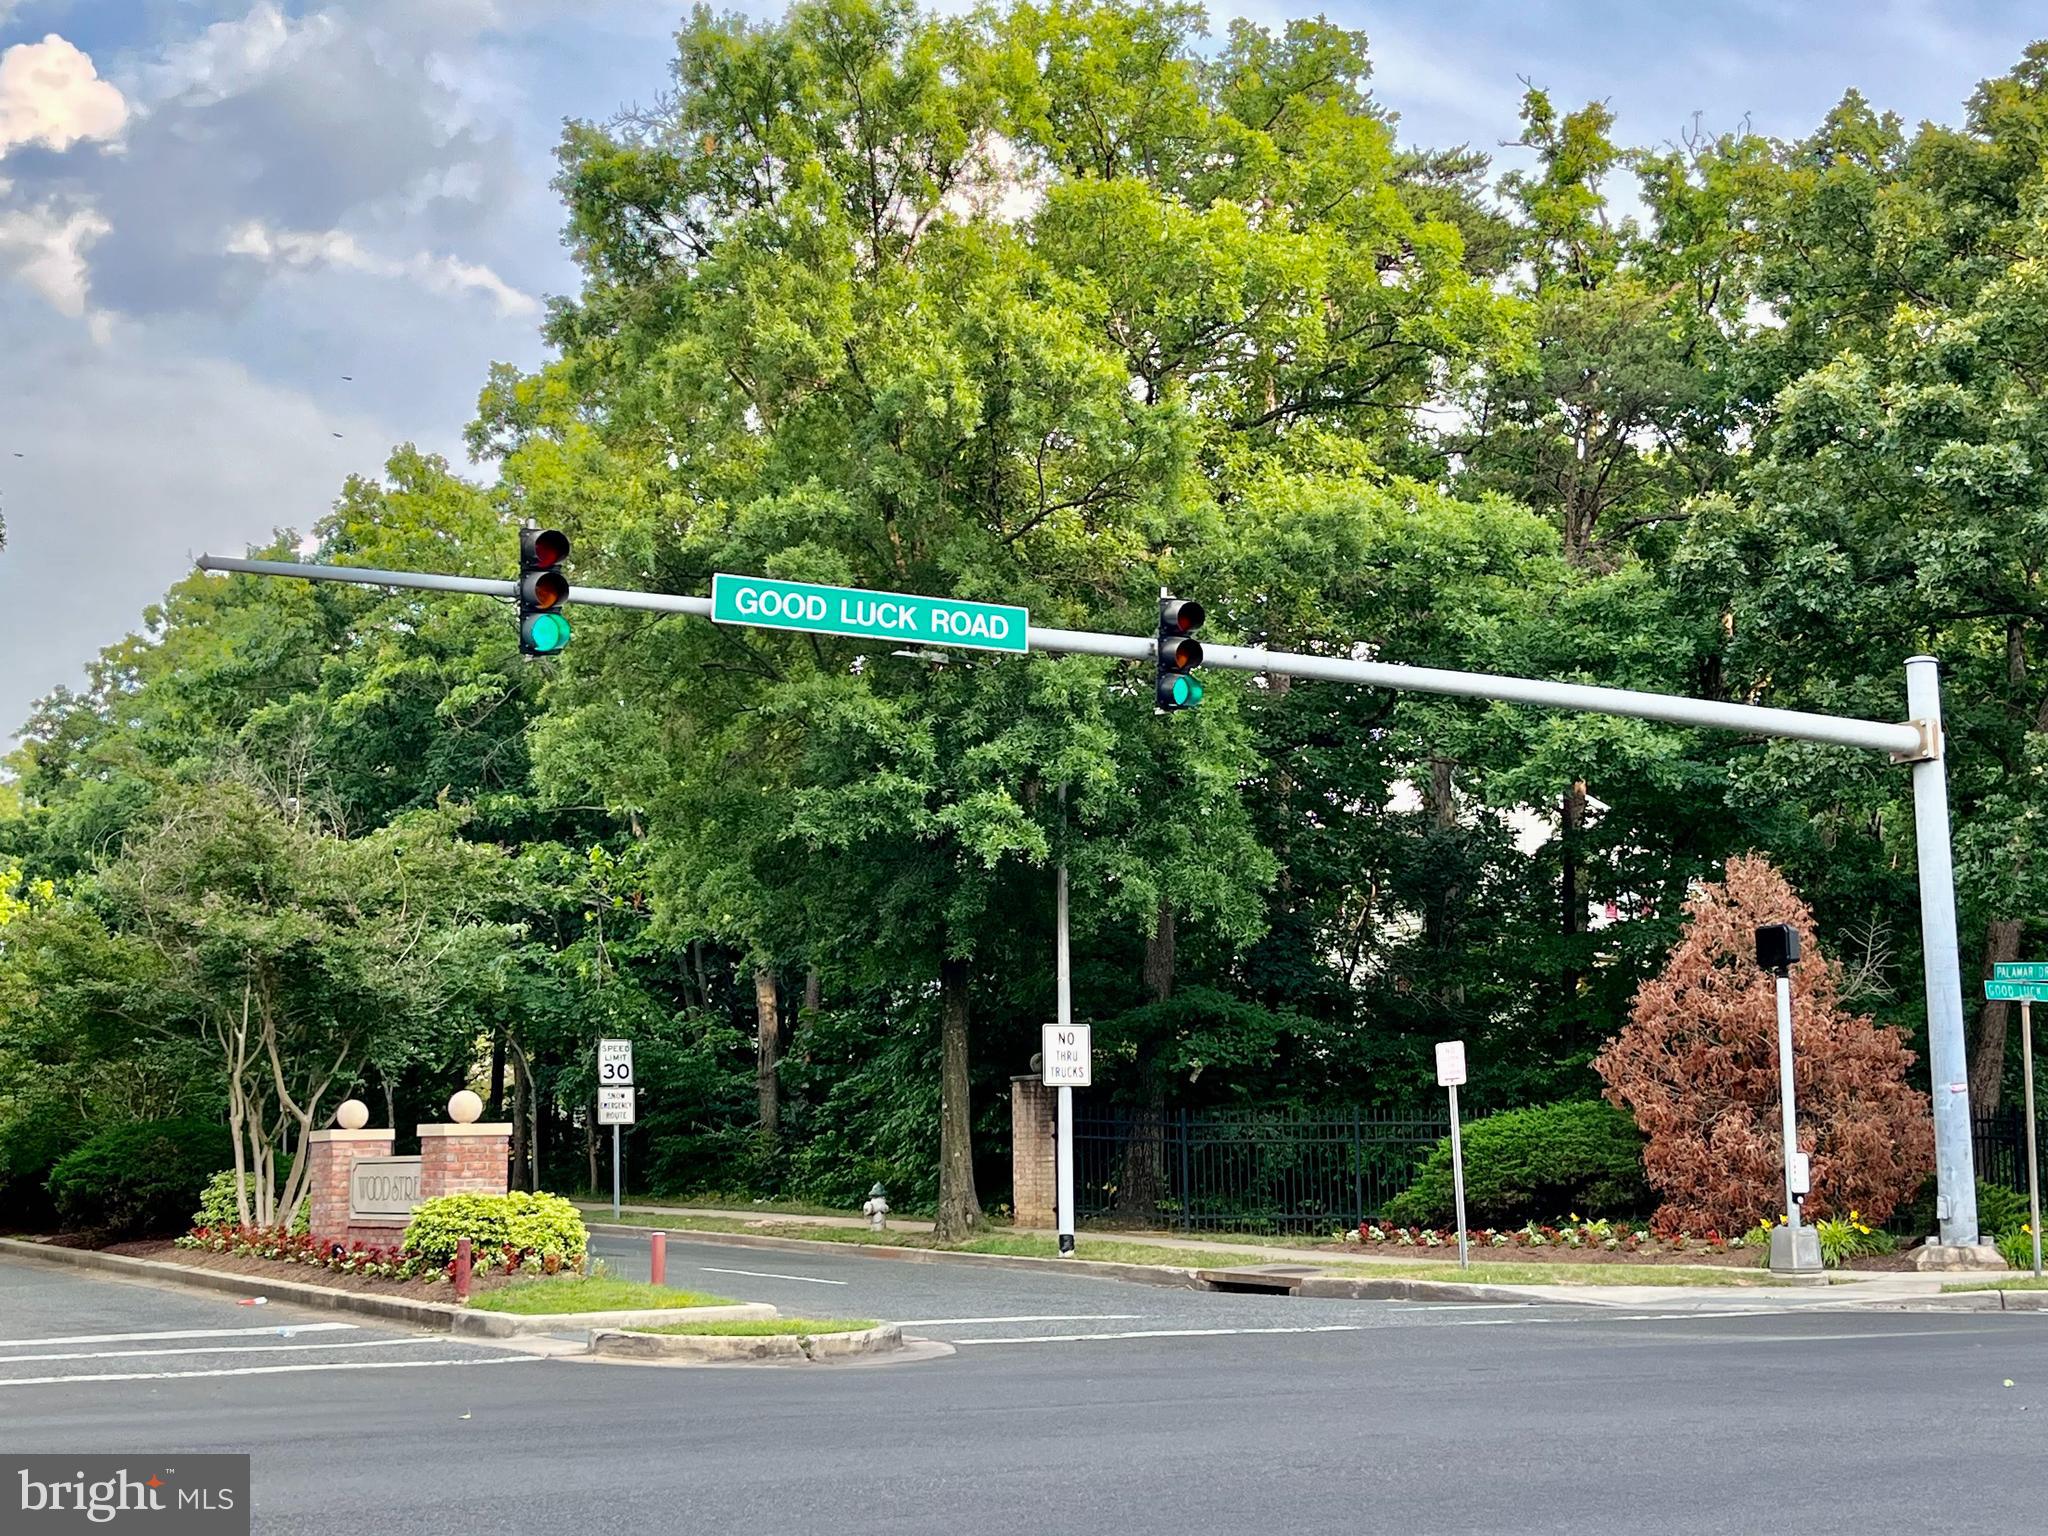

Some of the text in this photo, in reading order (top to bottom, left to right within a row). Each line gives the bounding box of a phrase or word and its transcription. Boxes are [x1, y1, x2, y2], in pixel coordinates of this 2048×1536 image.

[735, 587, 1009, 640] GOOD LUCK ROAD
[1996, 966, 2033, 978] PALAMAR
[1988, 984, 2041, 997] GOOD LUCK
[1058, 1032, 1075, 1045] NO
[1056, 1050, 1078, 1062] THRU
[603, 1063, 630, 1080] 30
[1051, 1067, 1084, 1078] TRUCKS
[606, 1111, 627, 1120] ROUTE
